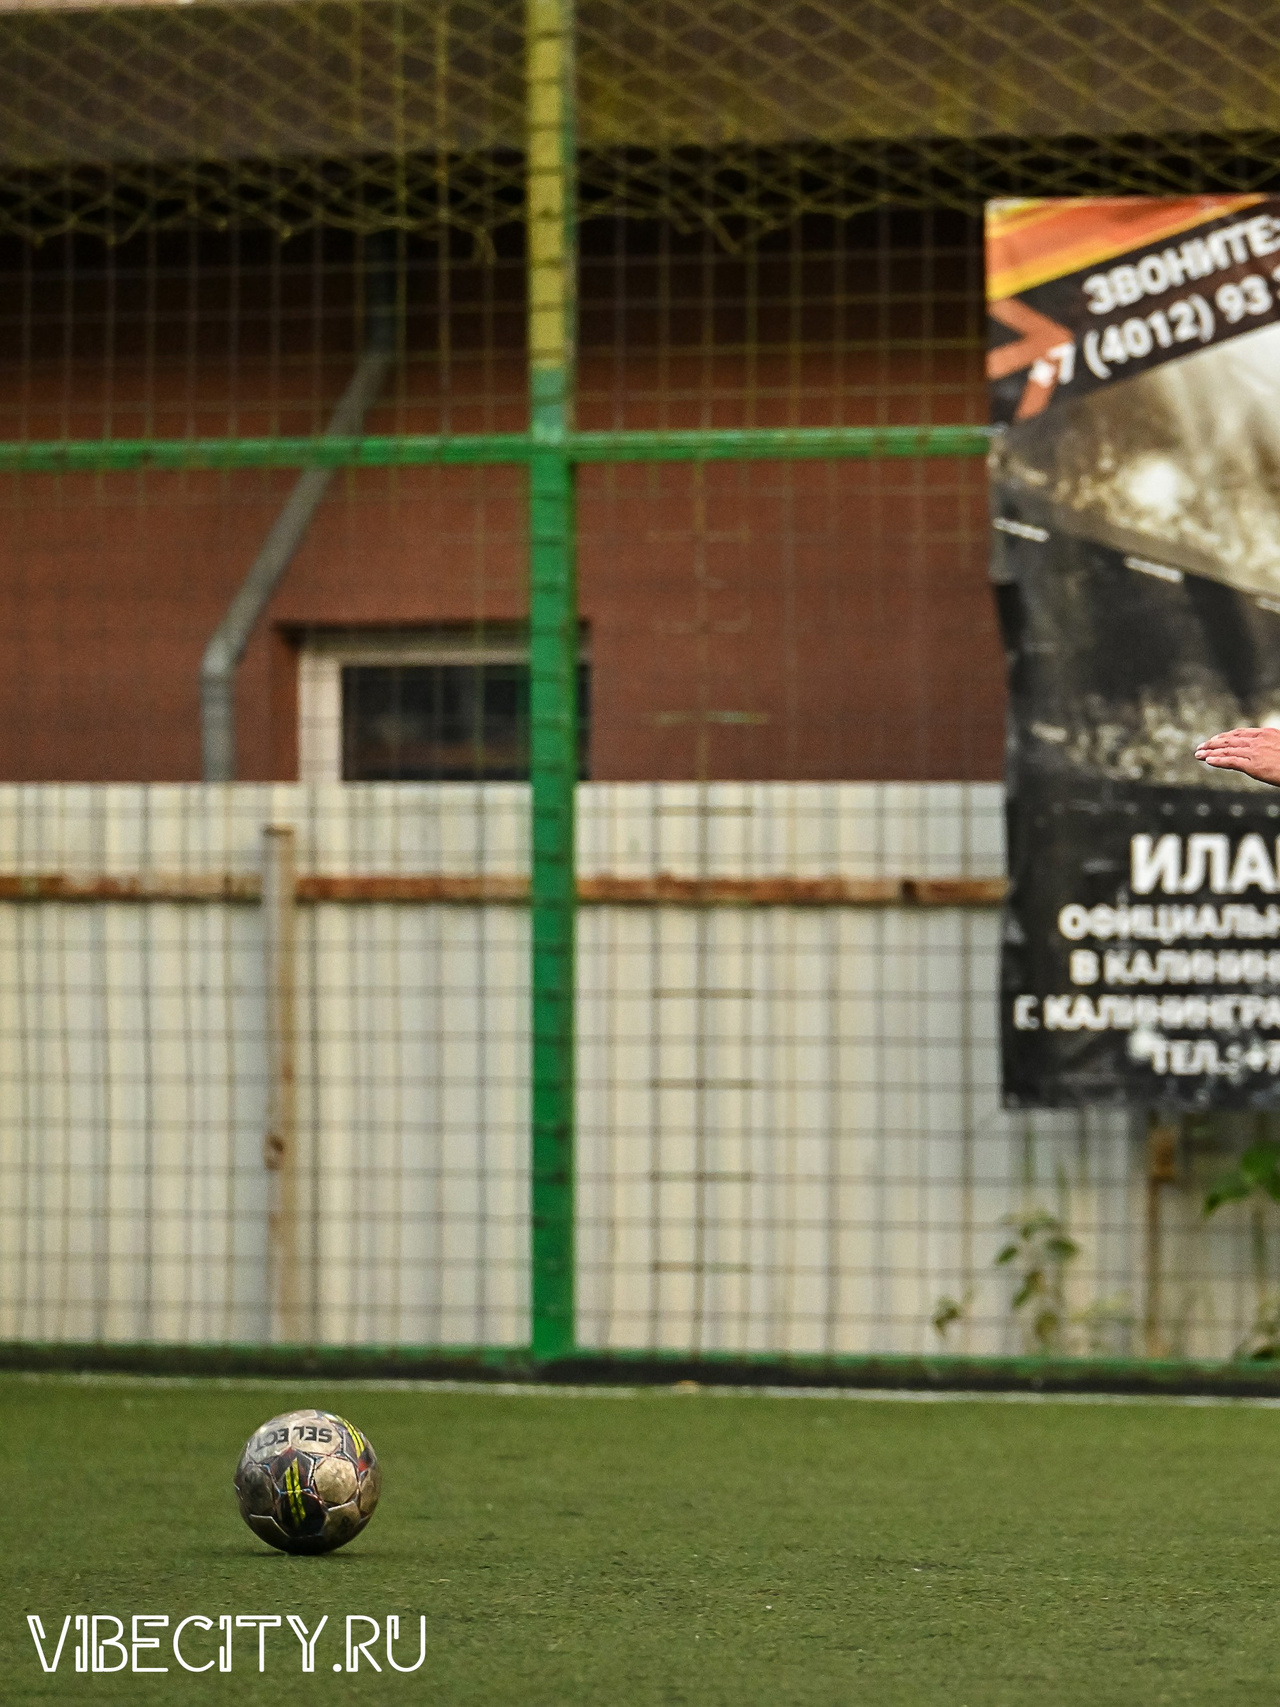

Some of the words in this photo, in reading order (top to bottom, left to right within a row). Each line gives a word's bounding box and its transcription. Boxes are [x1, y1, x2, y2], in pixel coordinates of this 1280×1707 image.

[1028, 341, 1077, 389] +7
[1083, 293, 1215, 379] (4012)
[1216, 281, 1271, 324] 93
[1070, 949, 1099, 985] В
[256, 1425, 333, 1451] SELECT
